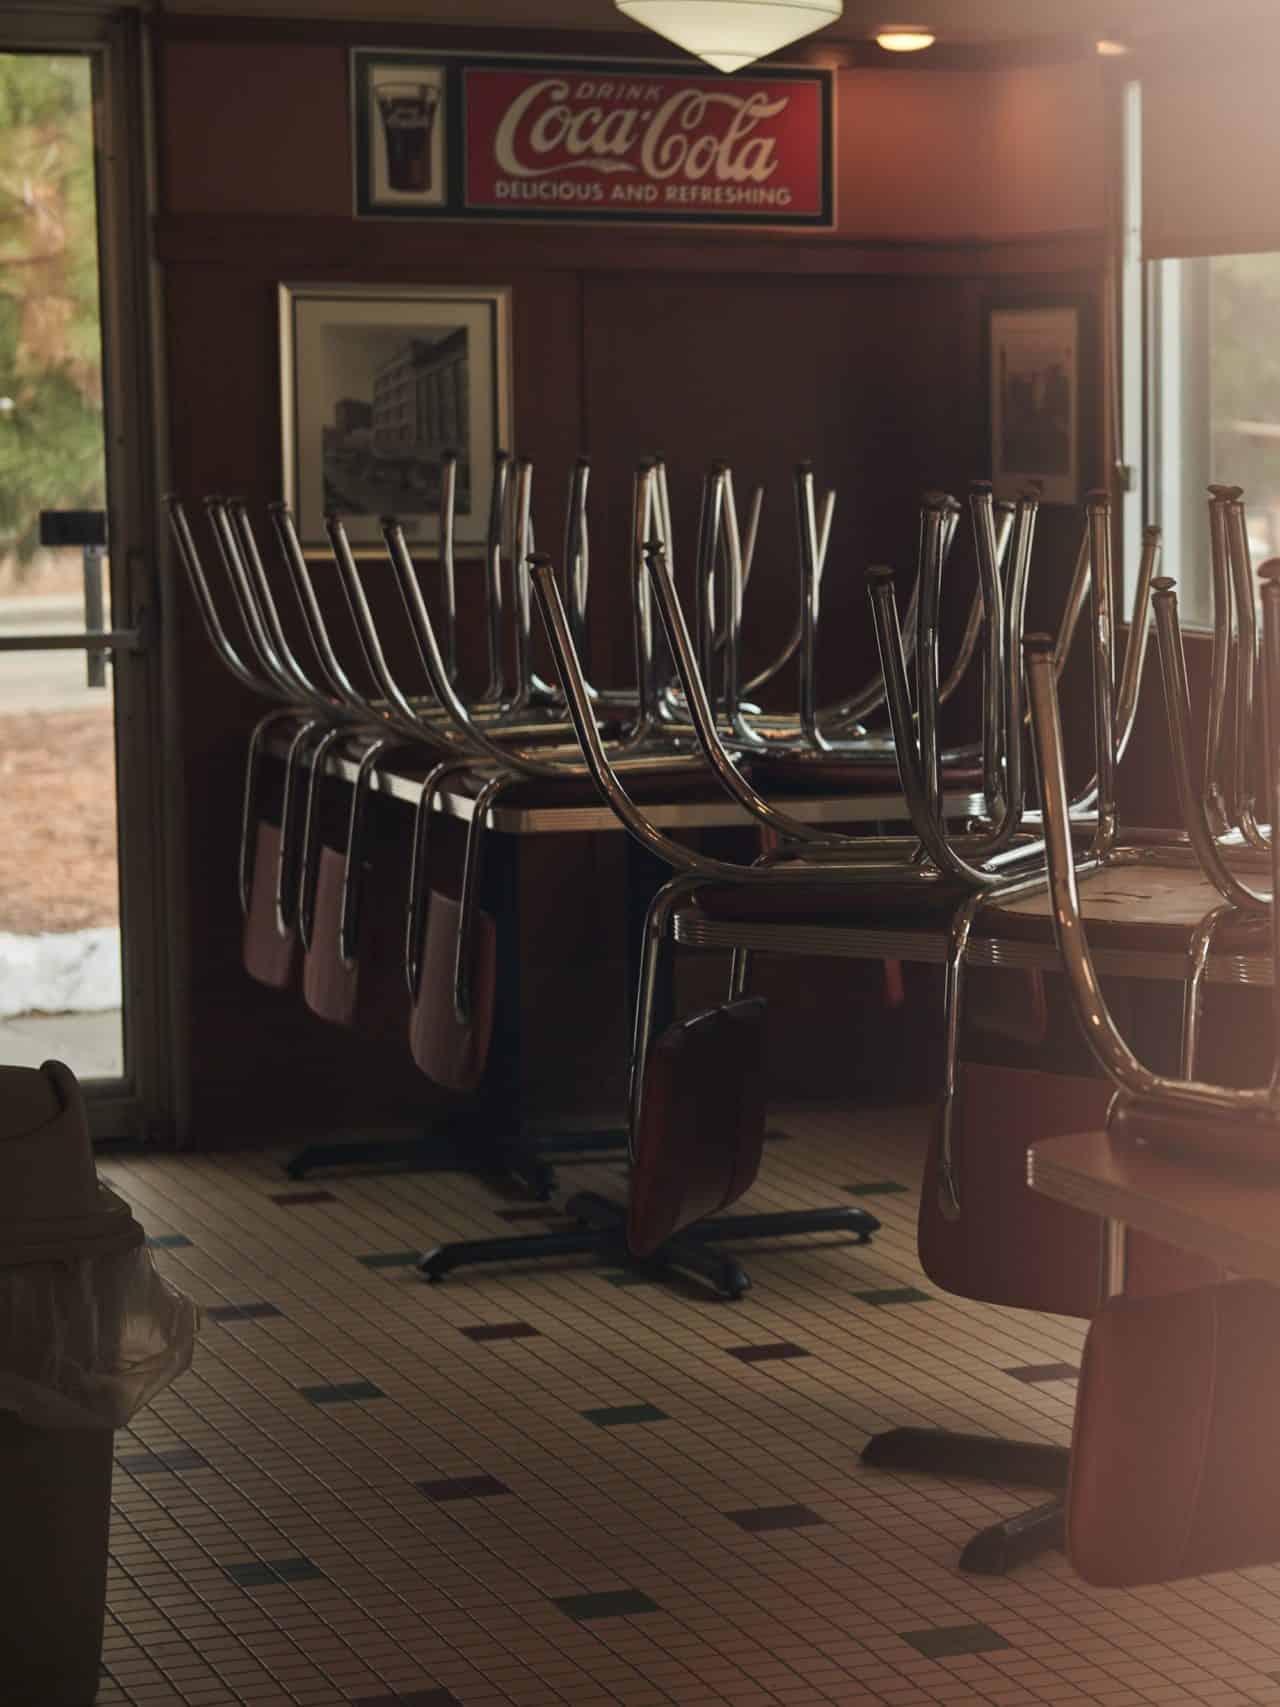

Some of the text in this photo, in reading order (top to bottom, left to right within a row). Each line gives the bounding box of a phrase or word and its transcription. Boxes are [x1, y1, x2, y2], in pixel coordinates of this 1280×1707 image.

[575, 81, 664, 100] DRINK
[494, 79, 789, 182] Coca-Cola
[495, 180, 793, 207] DELICIOUS AND REFRESHING
